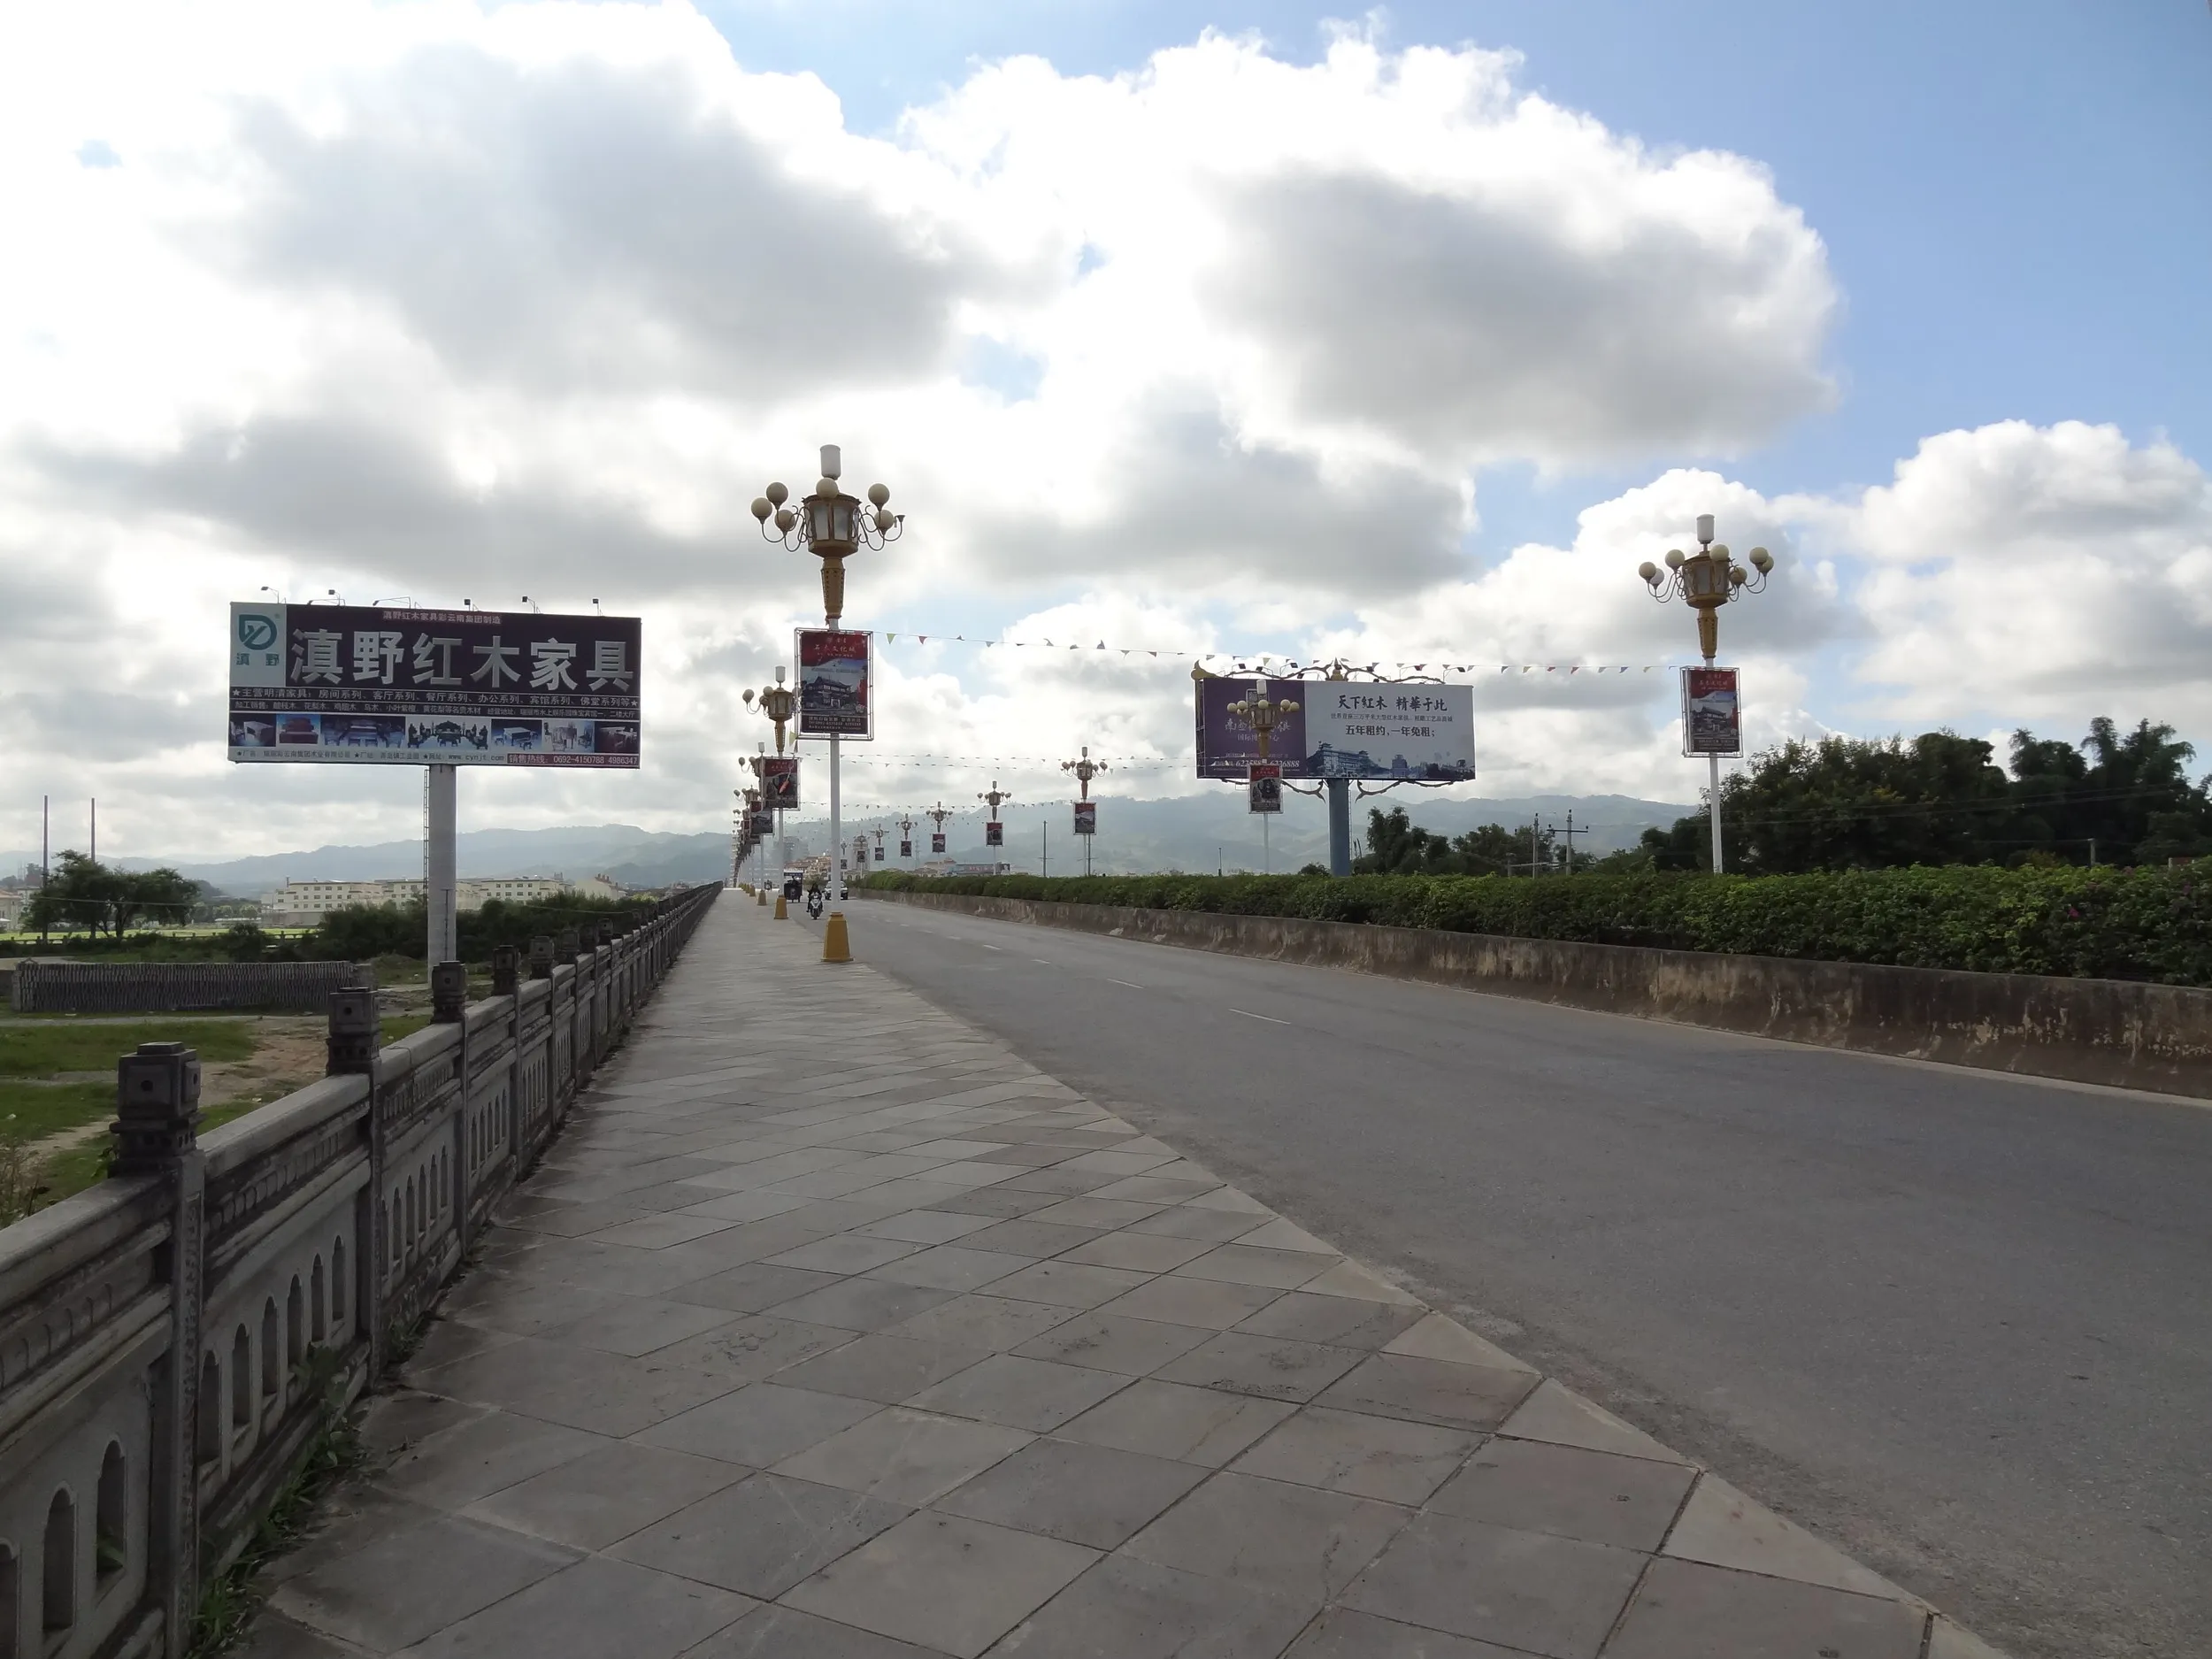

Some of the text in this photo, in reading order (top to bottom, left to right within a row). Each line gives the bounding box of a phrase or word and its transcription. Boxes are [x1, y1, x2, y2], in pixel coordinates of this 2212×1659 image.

[383, 611, 501, 624] 滇野红木家具彩云南集团制造
[290, 628, 634, 692] 滇野红木家具
[553, 754, 604, 764] 0692-4150788
[608, 756, 637, 765] 4986347
